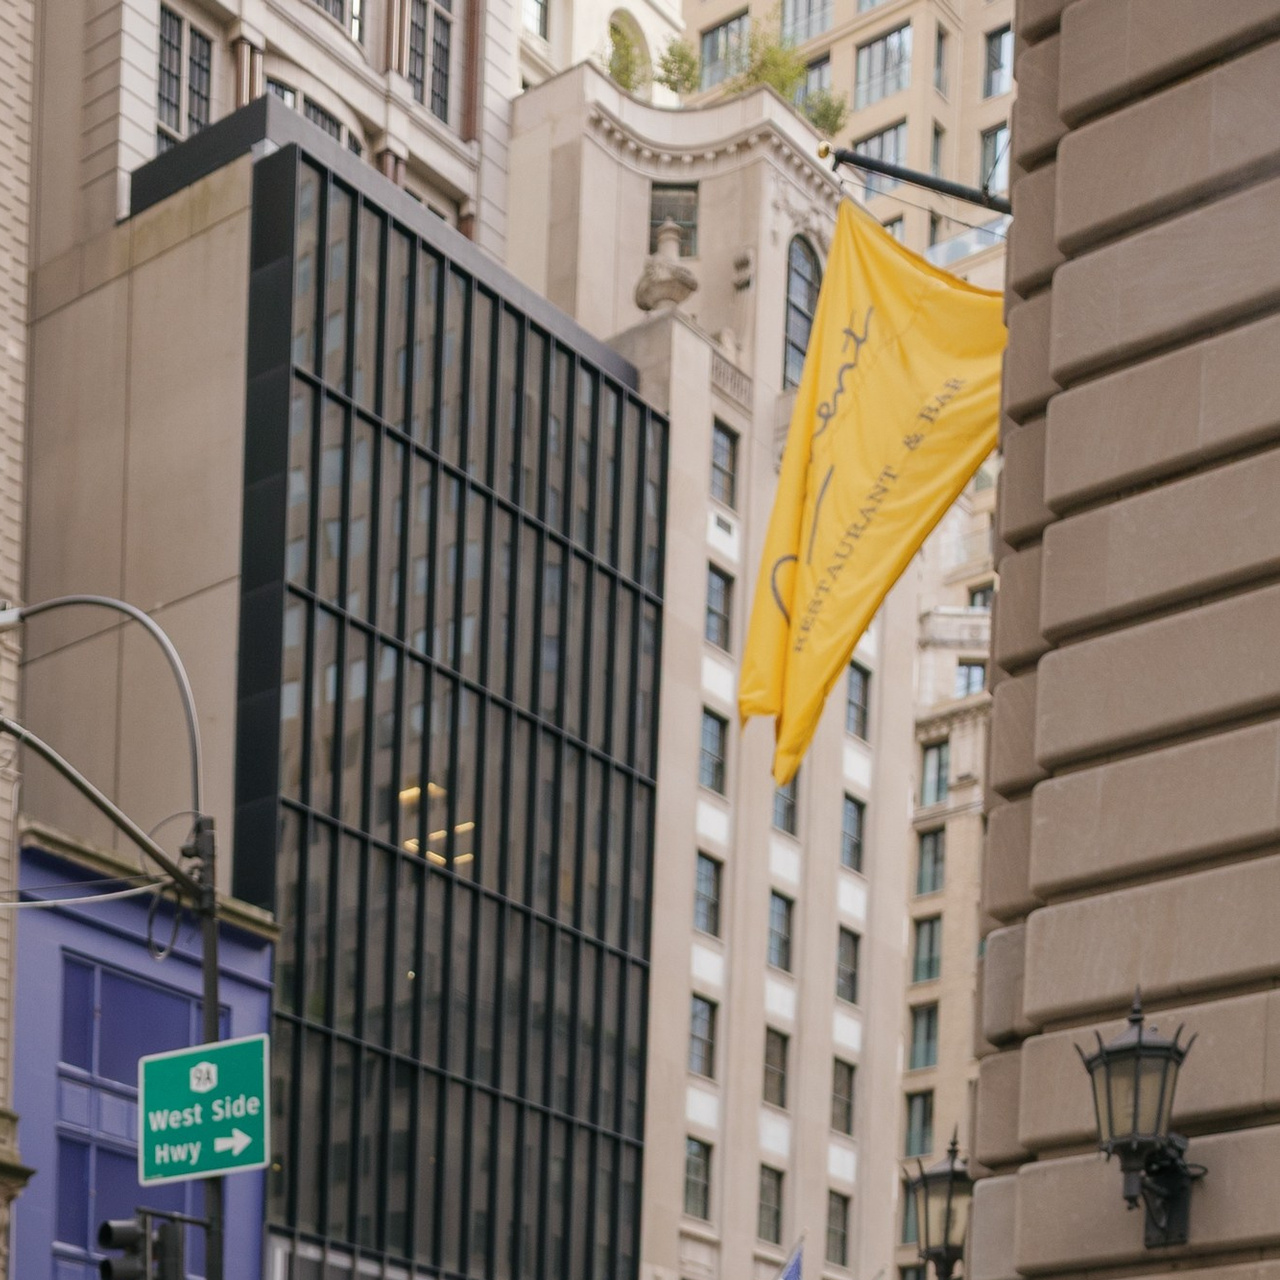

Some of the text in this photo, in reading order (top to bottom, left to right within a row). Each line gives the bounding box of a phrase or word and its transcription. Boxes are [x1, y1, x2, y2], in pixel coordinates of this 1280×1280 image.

[794, 464, 901, 653] RESTAURANT
[920, 375, 967, 423] BAR
[148, 1094, 261, 1132] West Side
[154, 1141, 202, 1165] Hwy
